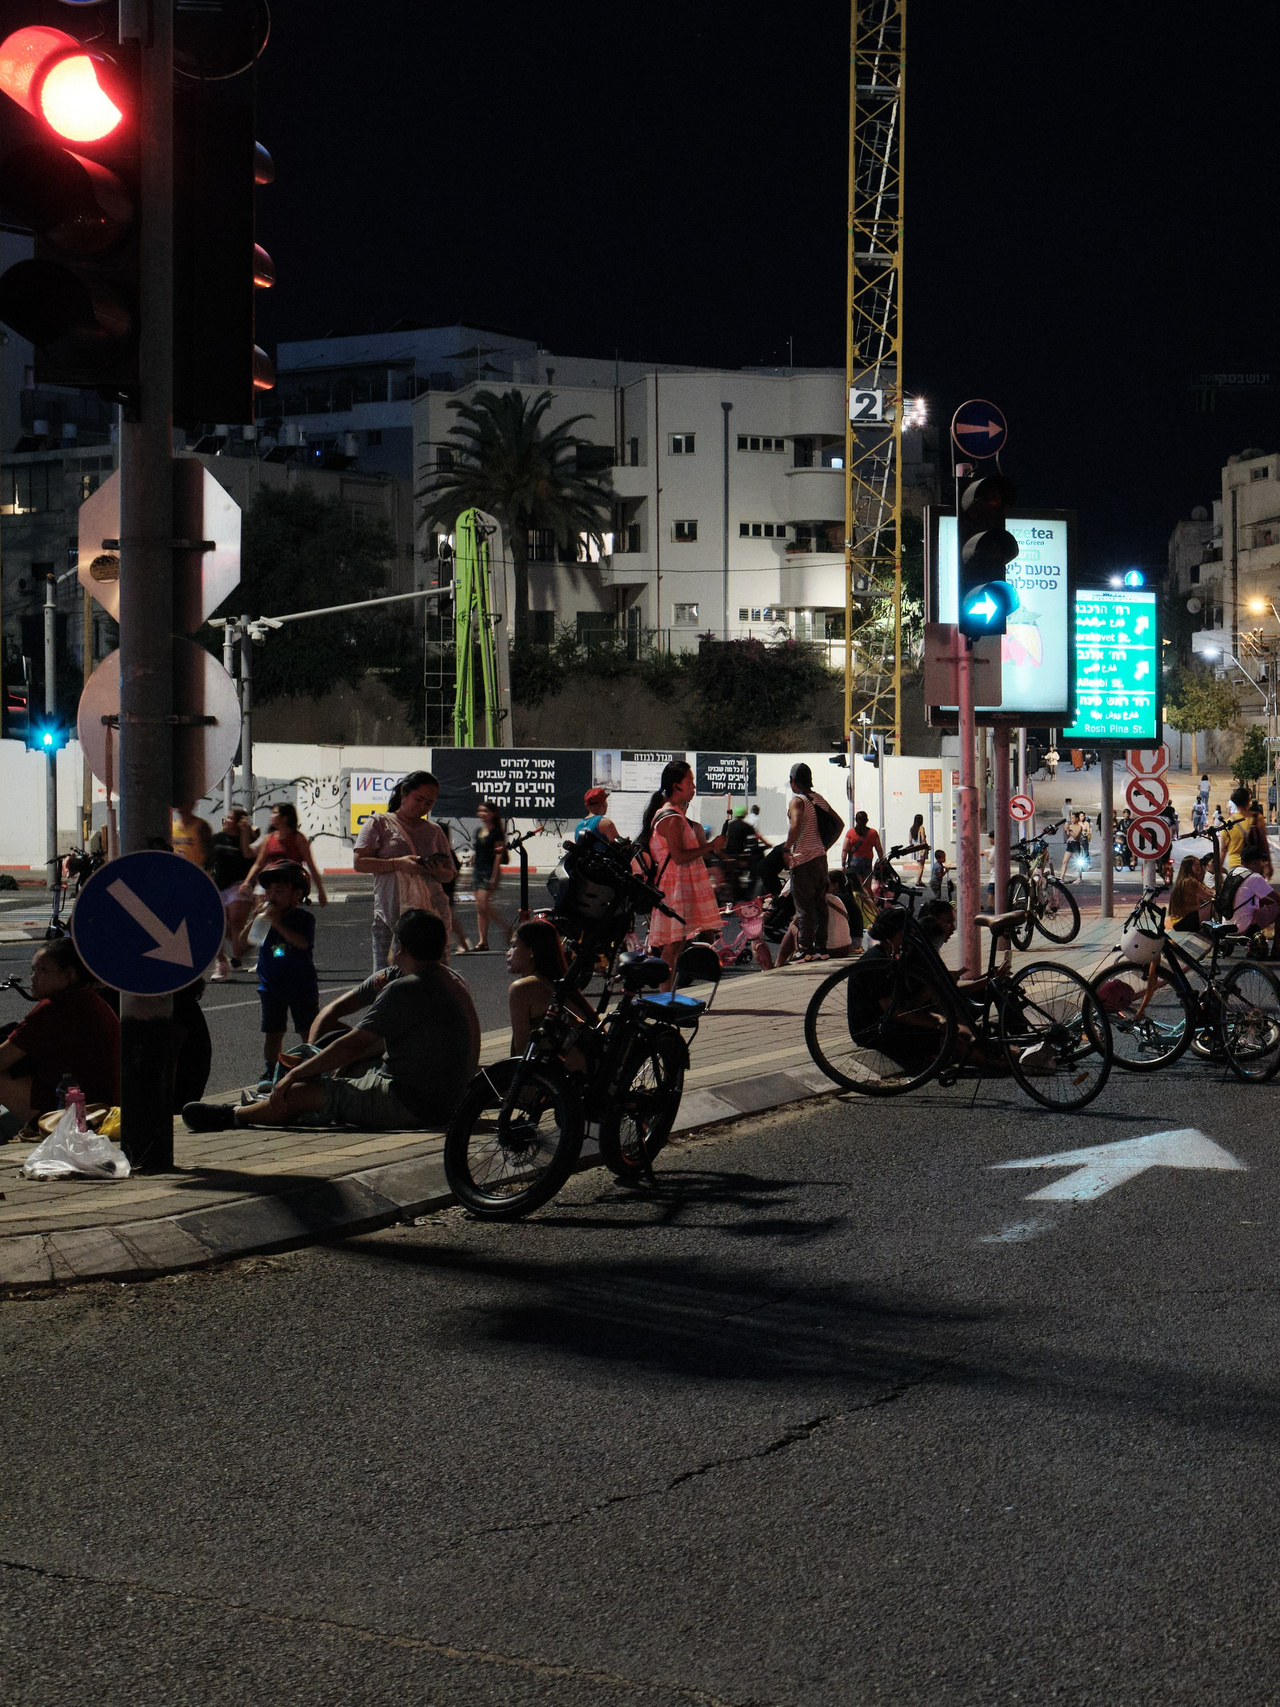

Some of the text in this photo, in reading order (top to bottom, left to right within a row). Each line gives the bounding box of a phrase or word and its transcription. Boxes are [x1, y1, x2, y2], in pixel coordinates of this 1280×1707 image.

[854, 392, 878, 419] 2
[1006, 562, 1061, 575] בטעם ליצ
[1007, 576, 1057, 590] פסיפלור
[1076, 632, 1115, 642] arakevet
[1077, 648, 1104, 660] אלנב
[1106, 696, 1129, 706] ראש
[1085, 724, 1145, 734] Rosh Pina St.
[656, 753, 673, 761] מגדל
[501, 758, 555, 768] אסור להרוס
[477, 769, 555, 779] את כל מה שבנינו
[705, 773, 726, 781] לפתור
[471, 781, 555, 793] חייבים לפתור
[712, 781, 726, 789] יחד!
[515, 796, 531, 807] זה
[534, 796, 555, 807] את
